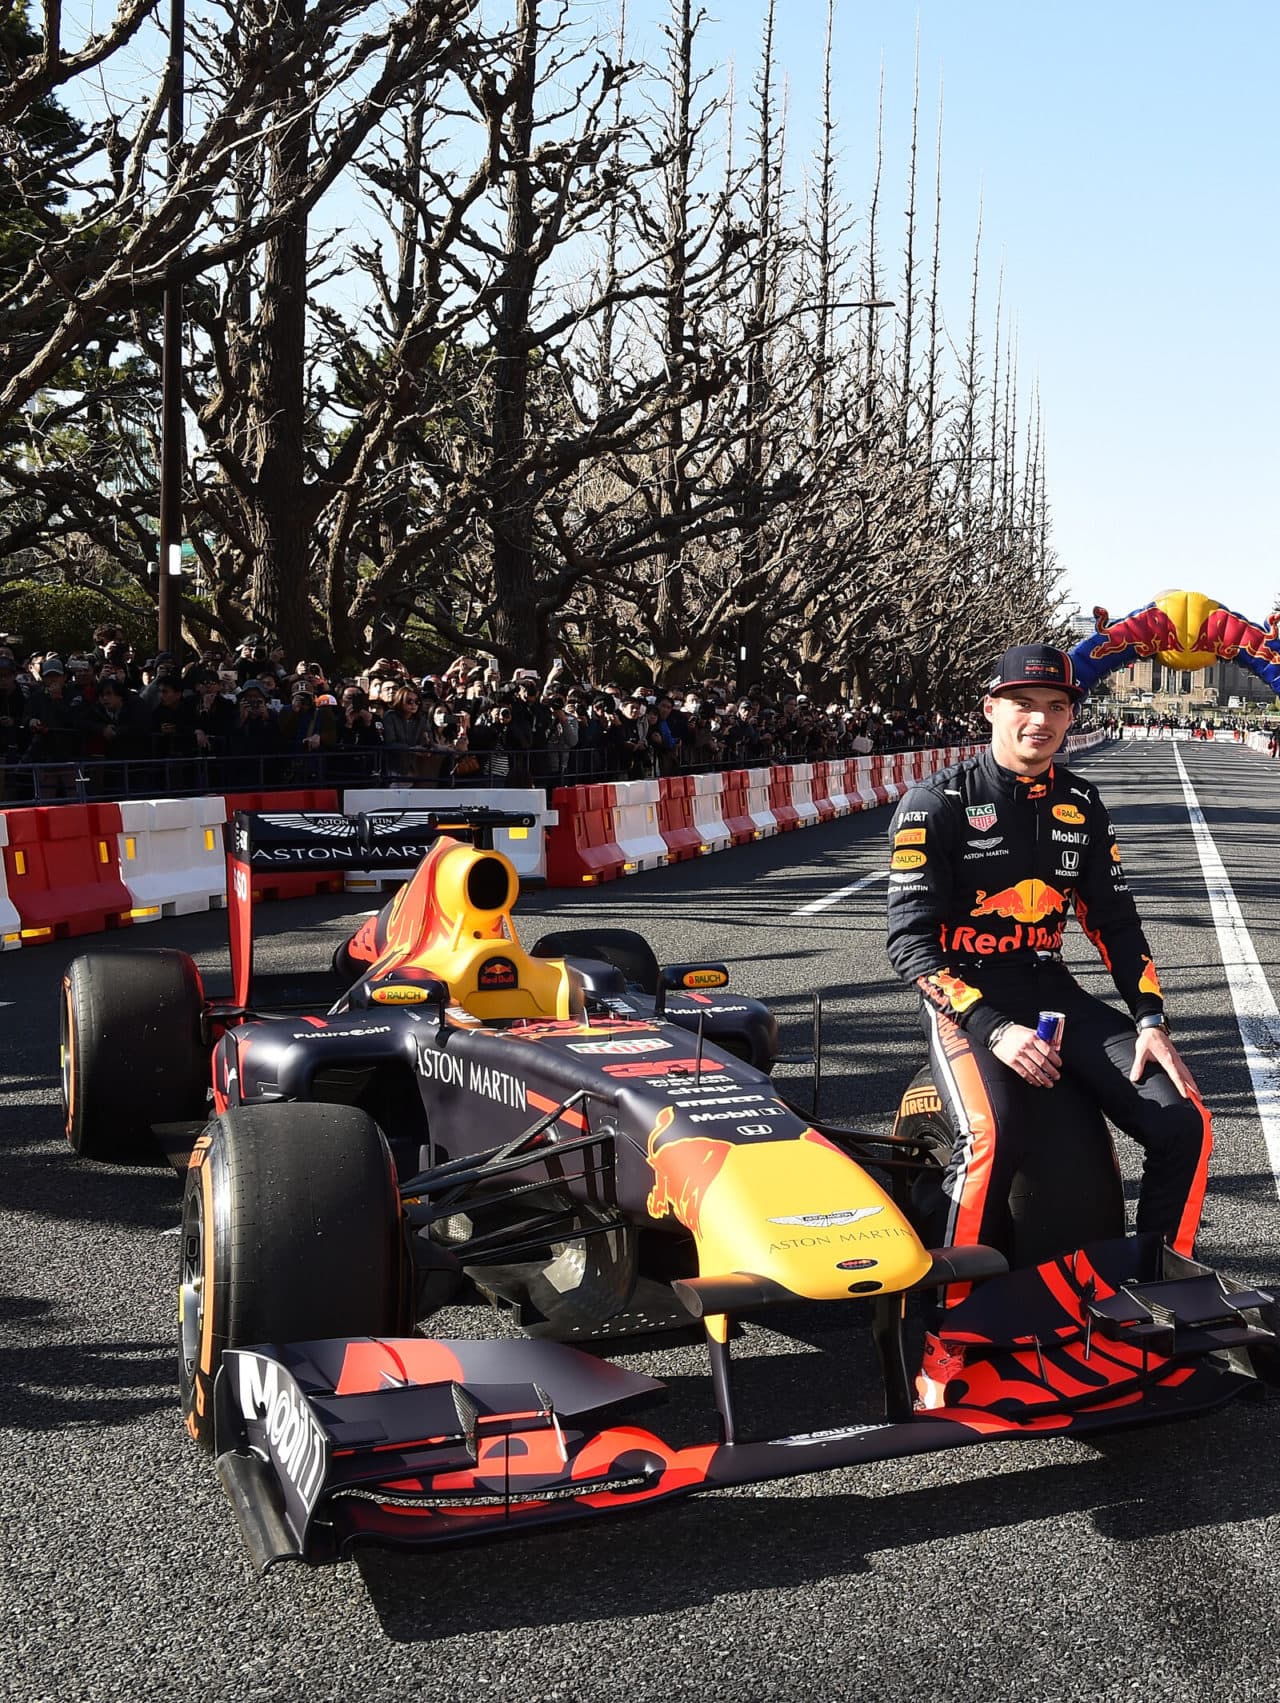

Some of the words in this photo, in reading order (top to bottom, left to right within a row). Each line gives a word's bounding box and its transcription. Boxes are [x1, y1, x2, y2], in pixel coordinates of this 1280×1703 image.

[903, 811, 928, 822] AT&T
[969, 807, 993, 816] TAG
[1052, 829, 1080, 843] Mobil
[251, 847, 353, 860] ASTON
[360, 845, 432, 857] MART
[964, 852, 984, 860] ASTON
[986, 849, 1009, 857] MARTIN
[952, 924, 1022, 955] Red
[694, 974, 720, 984] RAUCH
[387, 991, 421, 1000] RAUCH
[469, 1061, 526, 1112] MARTIN
[689, 1108, 759, 1123] Mobil
[769, 1235, 831, 1254] ASTON
[840, 1228, 913, 1242] MARTIN
[238, 1353, 310, 1483] Mobil
